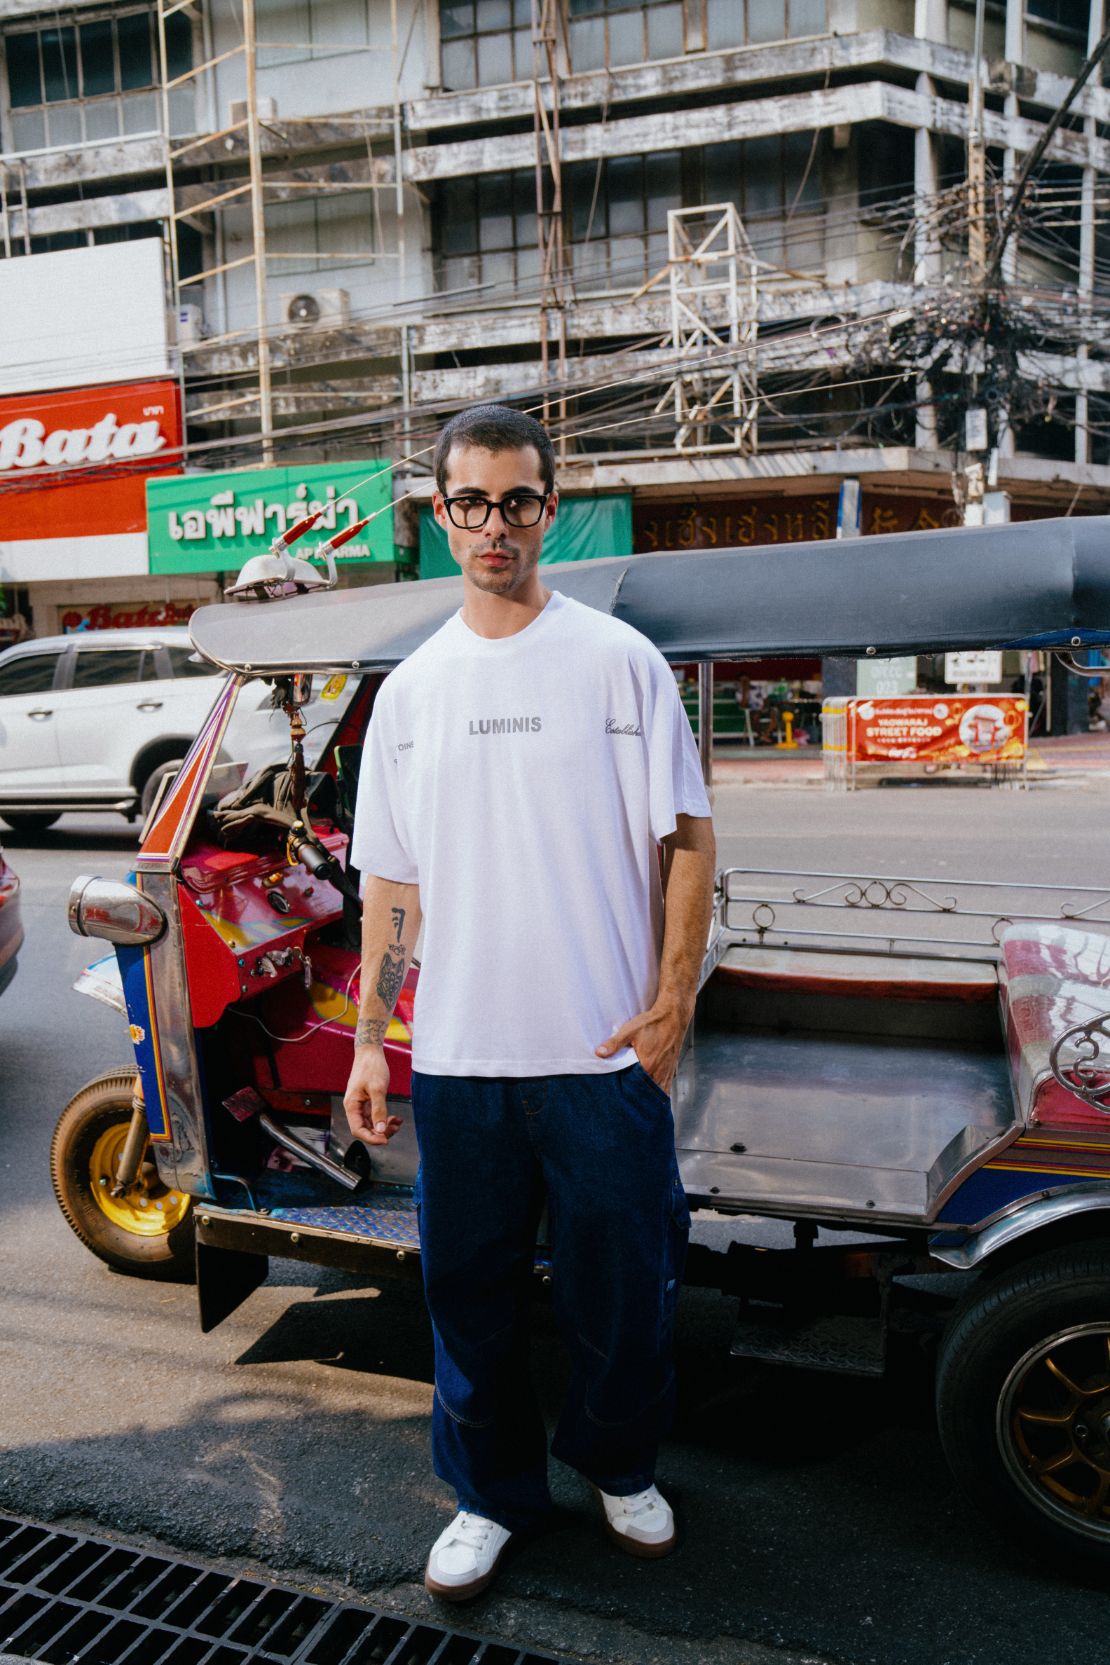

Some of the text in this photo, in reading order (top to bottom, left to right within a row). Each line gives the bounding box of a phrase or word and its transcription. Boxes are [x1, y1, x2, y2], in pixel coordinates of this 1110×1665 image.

[0, 413, 166, 470] Bata
[469, 716, 542, 735] LUMINIS
[866, 726, 942, 737] STREET FOOD
